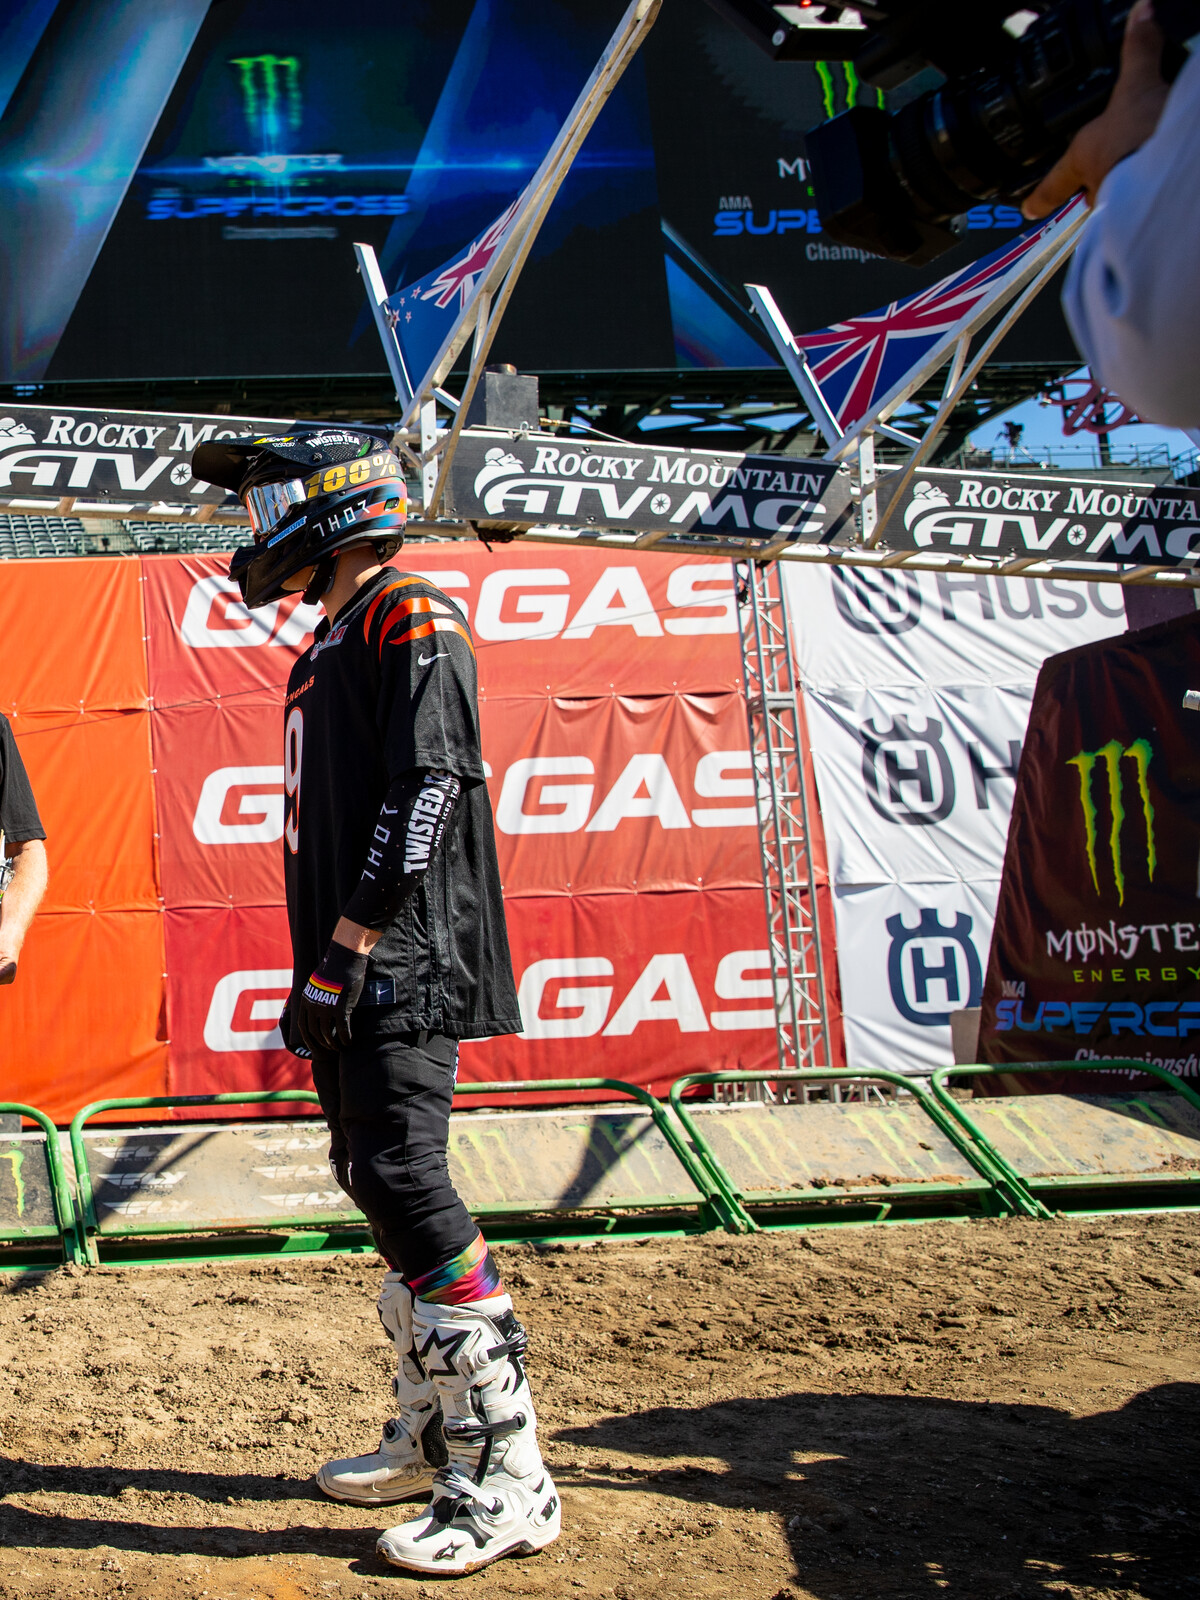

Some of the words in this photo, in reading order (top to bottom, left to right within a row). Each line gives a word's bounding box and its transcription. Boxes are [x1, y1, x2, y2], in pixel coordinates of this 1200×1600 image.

[718, 196, 752, 211] AMA
[42, 415, 166, 449] ROCKY
[306, 435, 343, 448] TWISTED
[344, 435, 360, 445] TEA
[305, 453, 397, 498] 100%
[530, 446, 643, 480] ROCKY
[647, 455, 825, 496] MOUNTAIN
[955, 480, 1060, 512] ROCKY
[1064, 487, 1200, 520] MOUNTA
[403, 787, 445, 874] TWISTED
[434, 823, 445, 848] HARD
[441, 801, 453, 820] ICED
[450, 784, 459, 799] TEA
[1046, 920, 1200, 963] MONSTE
